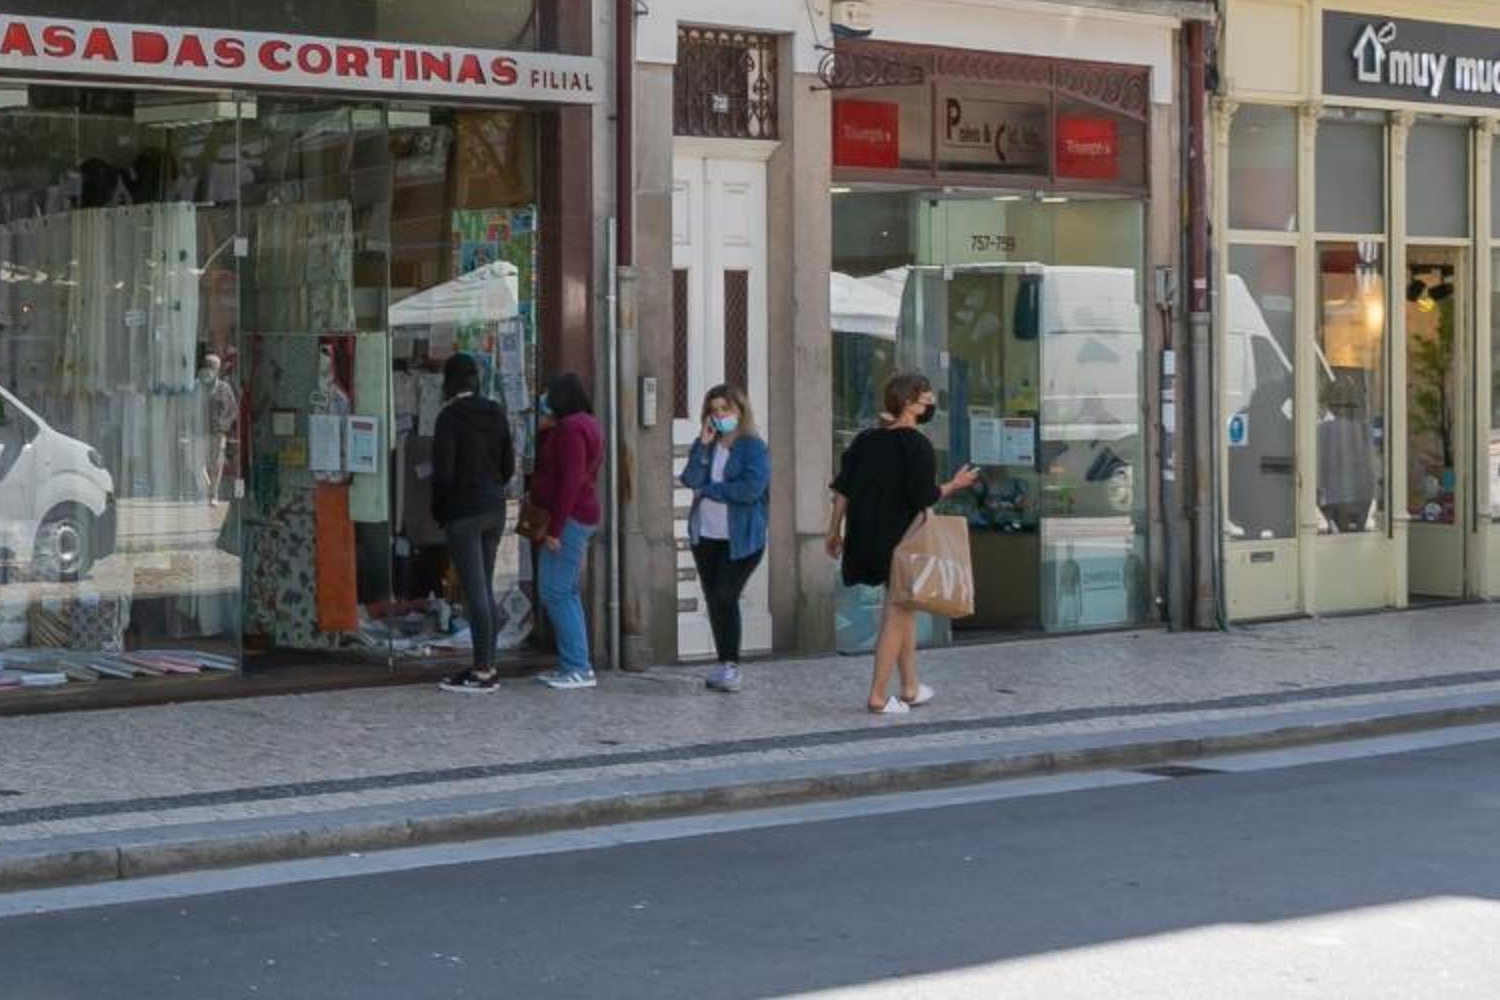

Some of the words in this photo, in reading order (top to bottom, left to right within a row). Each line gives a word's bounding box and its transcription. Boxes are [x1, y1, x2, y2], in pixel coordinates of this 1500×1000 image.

[131, 30, 246, 68] DAS
[258, 40, 518, 86] CORTINAS
[529, 70, 594, 91] FILIAL
[1389, 51, 1448, 97] muy
